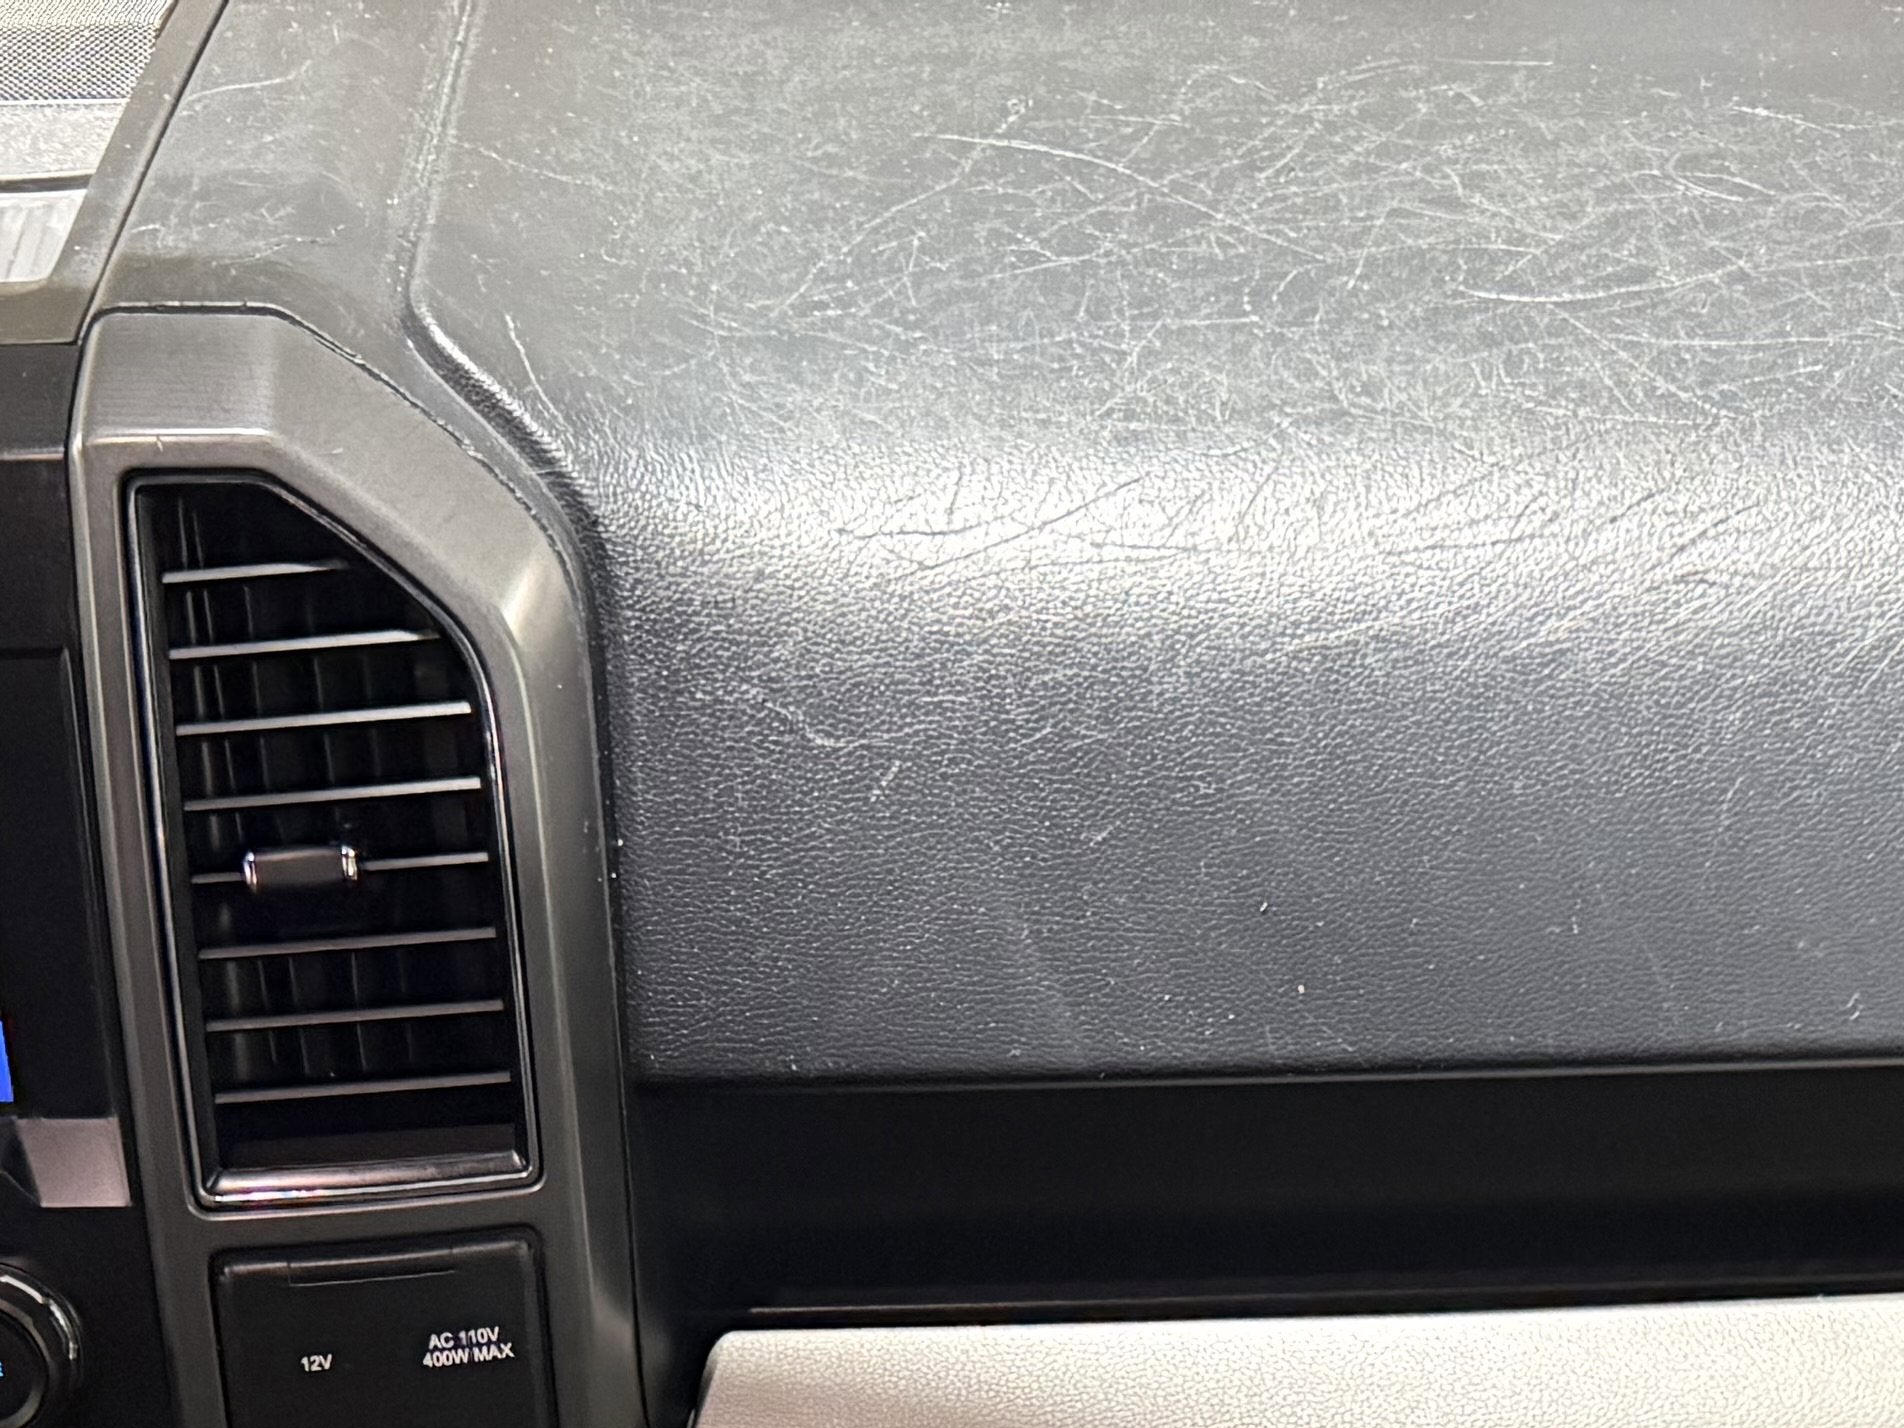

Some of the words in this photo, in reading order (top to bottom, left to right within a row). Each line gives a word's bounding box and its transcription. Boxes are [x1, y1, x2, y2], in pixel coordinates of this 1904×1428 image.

[428, 1333, 453, 1350] AC
[458, 1326, 500, 1347] 110V
[301, 1354, 333, 1372] 12V
[422, 1350, 470, 1369] 400W
[472, 1341, 515, 1363] MAX
